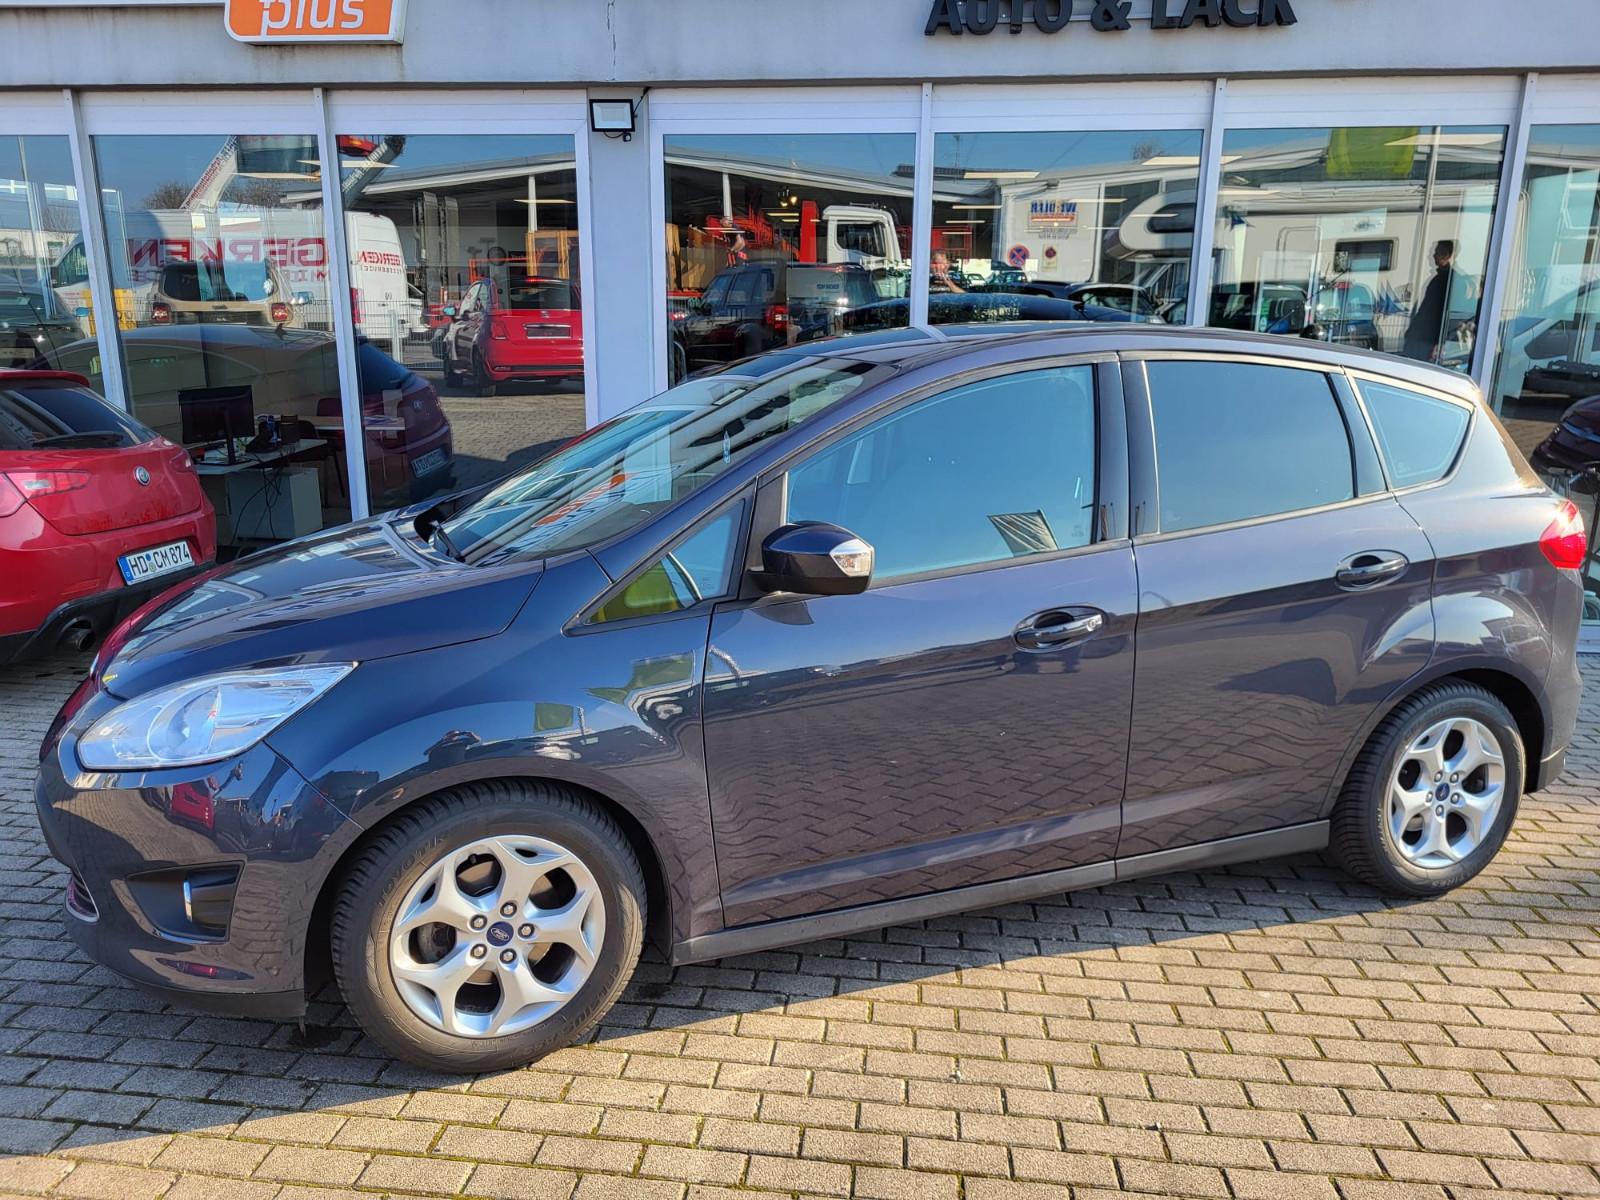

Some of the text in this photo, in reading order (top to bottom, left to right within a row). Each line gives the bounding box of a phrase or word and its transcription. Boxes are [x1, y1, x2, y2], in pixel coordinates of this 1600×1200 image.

[259, 0, 365, 36] plus
[924, 0, 1074, 35] AUTO
[1150, 0, 1298, 30] LACK
[128, 544, 189, 576] HD CM 874
